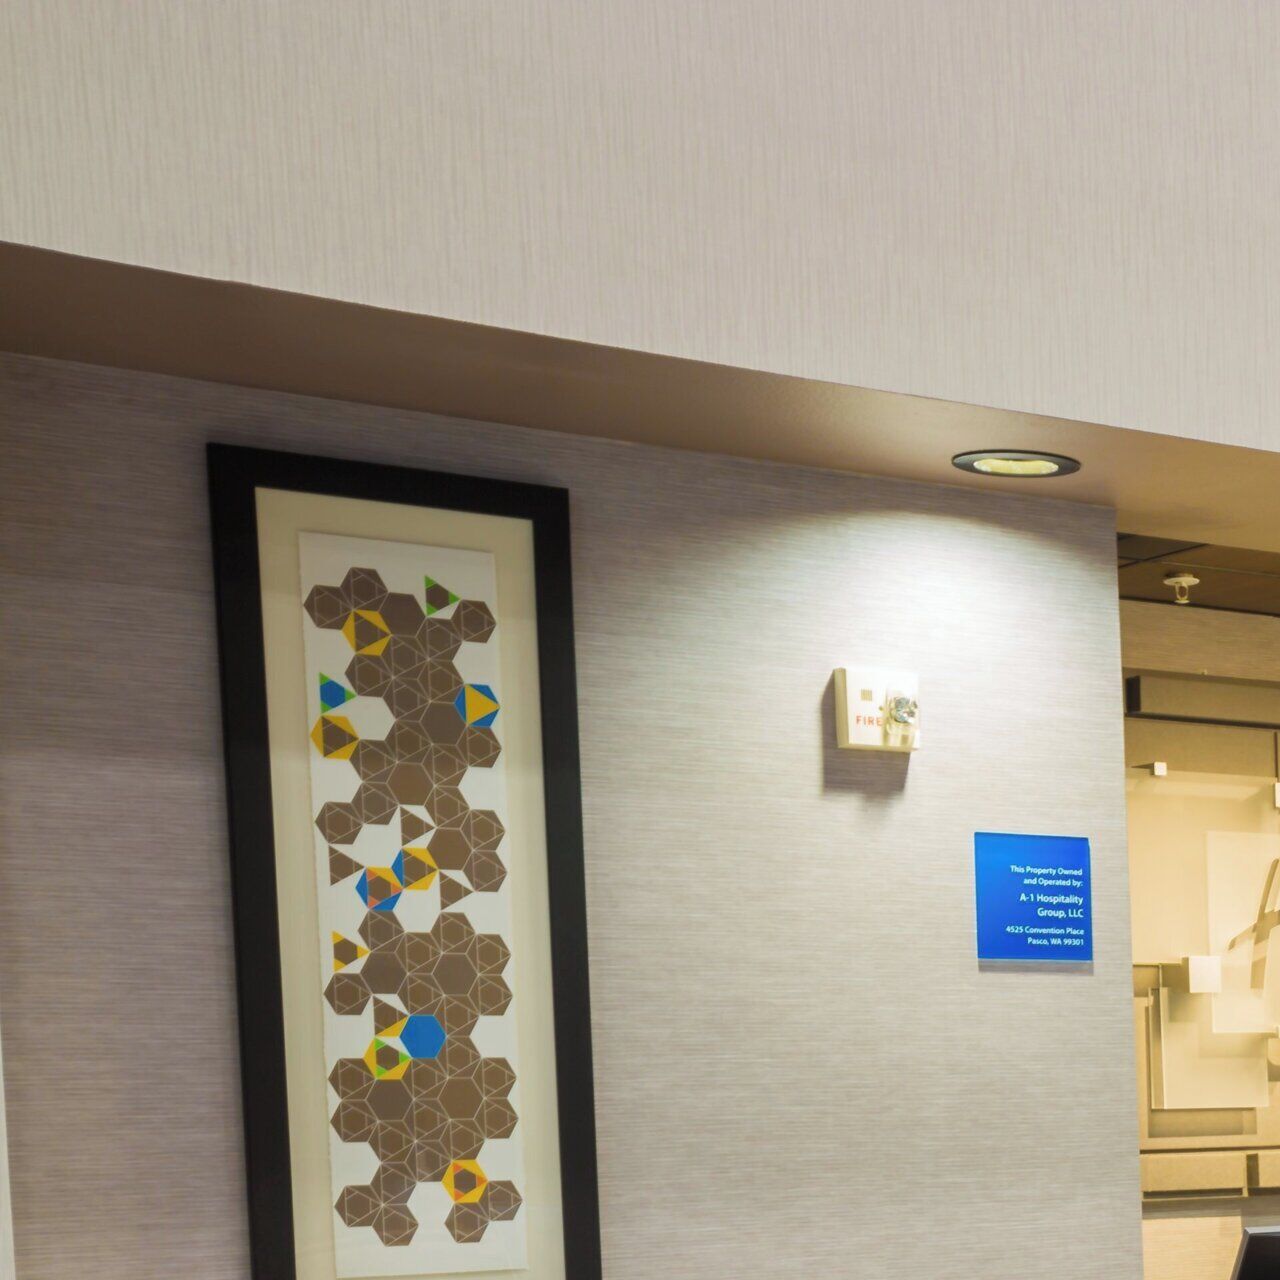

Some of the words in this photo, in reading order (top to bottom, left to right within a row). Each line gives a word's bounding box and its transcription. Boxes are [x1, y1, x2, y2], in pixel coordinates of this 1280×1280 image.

[855, 715, 883, 727] FIRE
[1010, 865, 1025, 874] This
[1026, 866, 1056, 876] Property
[1057, 868, 1083, 876] Owned
[1023, 877, 1037, 886] and
[1038, 877, 1071, 887] Operated
[1072, 878, 1083, 888] by:
[1019, 892, 1034, 902] A-1
[1036, 893, 1084, 905] Hospitality
[1037, 907, 1067, 919] Group,
[1068, 909, 1084, 918] LLC
[1005, 925, 1023, 933] 4525
[1024, 926, 1065, 935] Convention
[1066, 927, 1085, 935] Place
[1027, 937, 1050, 946] Pasco,
[1050, 937, 1062, 946] WA
[1063, 938, 1084, 946] 99301
